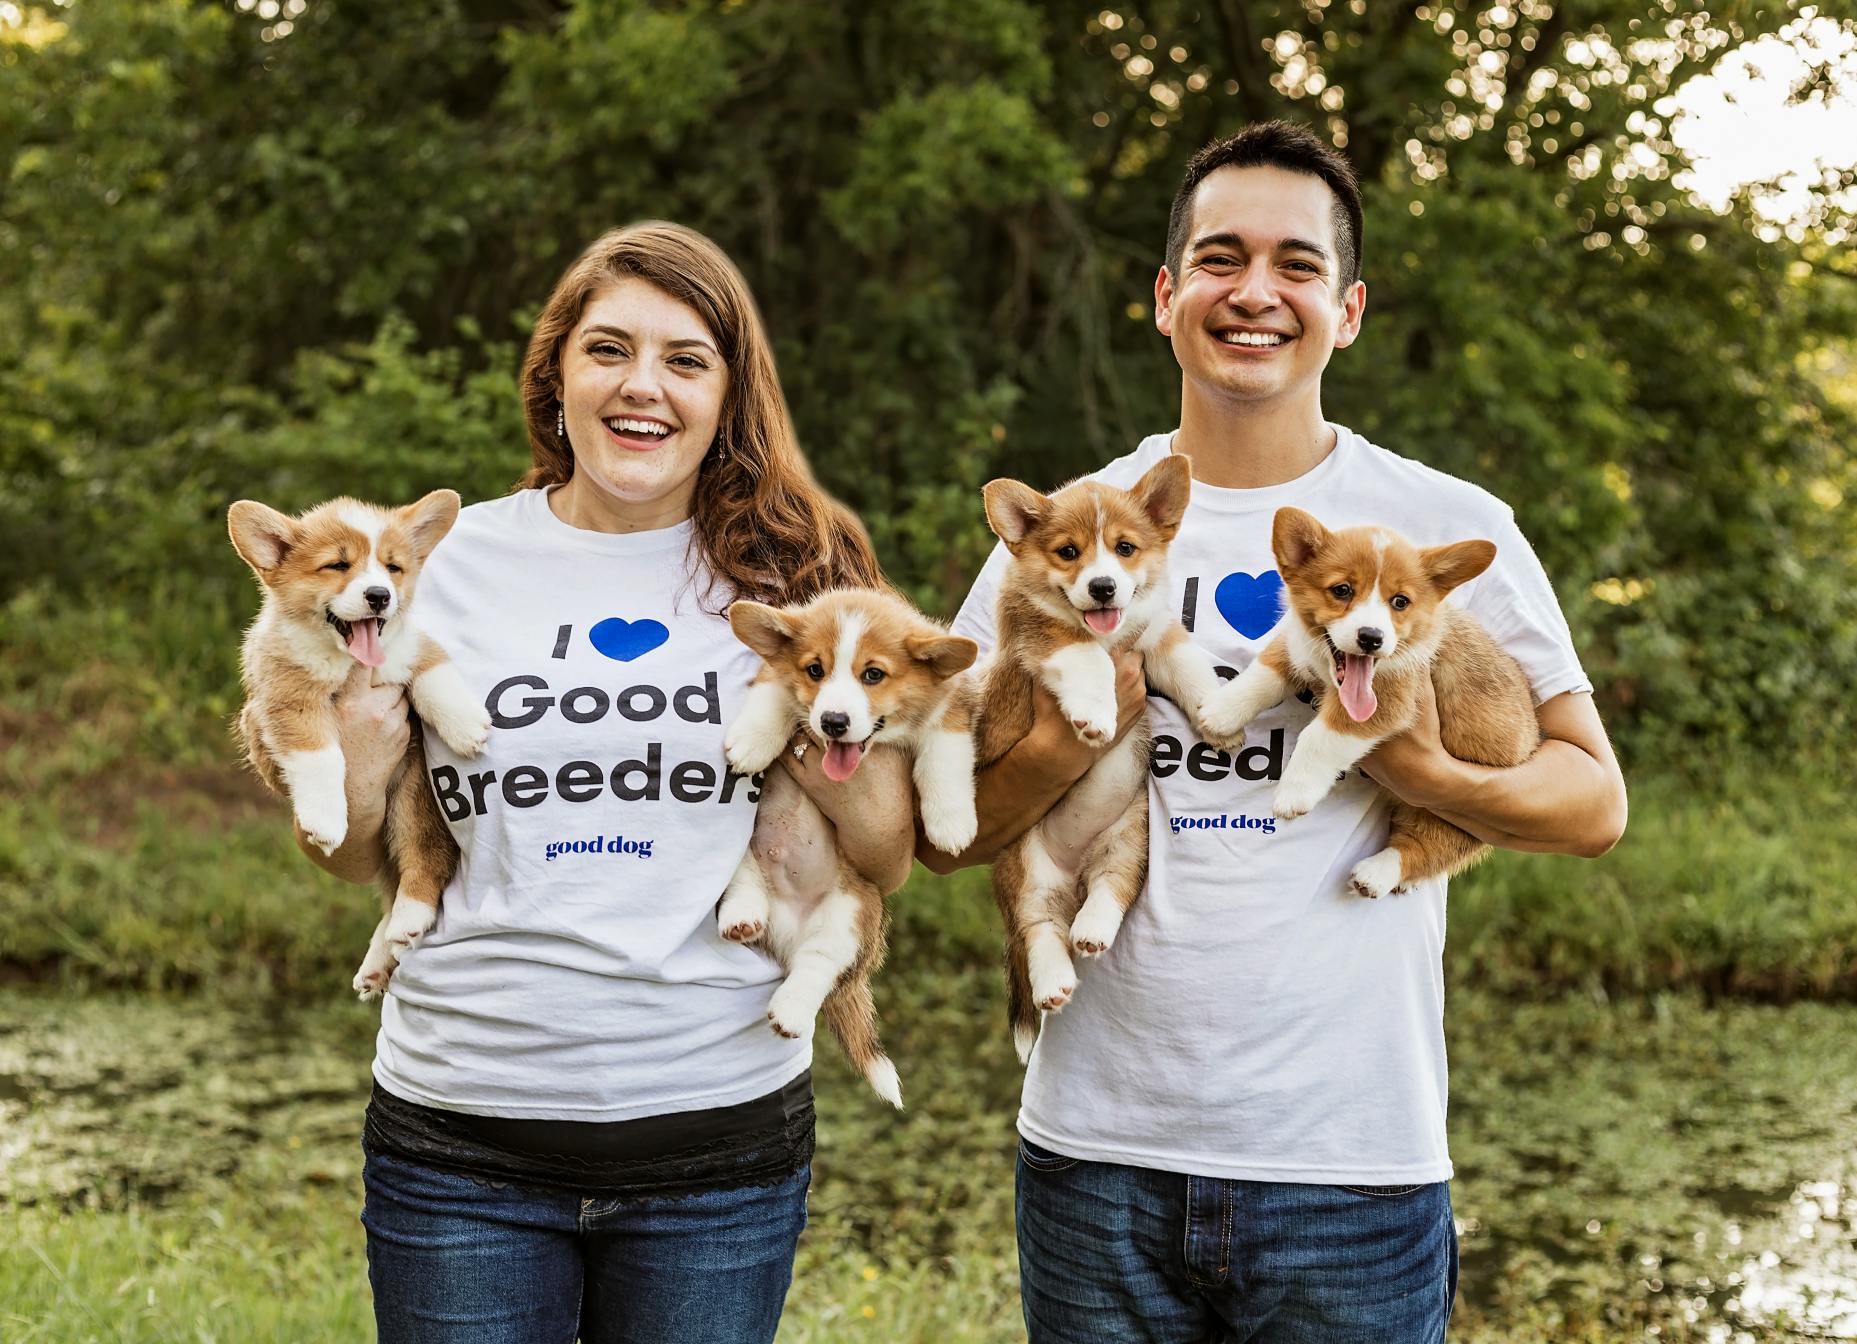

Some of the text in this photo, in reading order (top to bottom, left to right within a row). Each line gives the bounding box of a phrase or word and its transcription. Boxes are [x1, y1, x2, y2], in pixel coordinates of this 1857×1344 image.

[1181, 576, 1199, 633] I
[551, 624, 573, 660] I
[485, 671, 722, 729] Good
[1170, 814, 1276, 834] good dog
[546, 835, 654, 861] good dog
